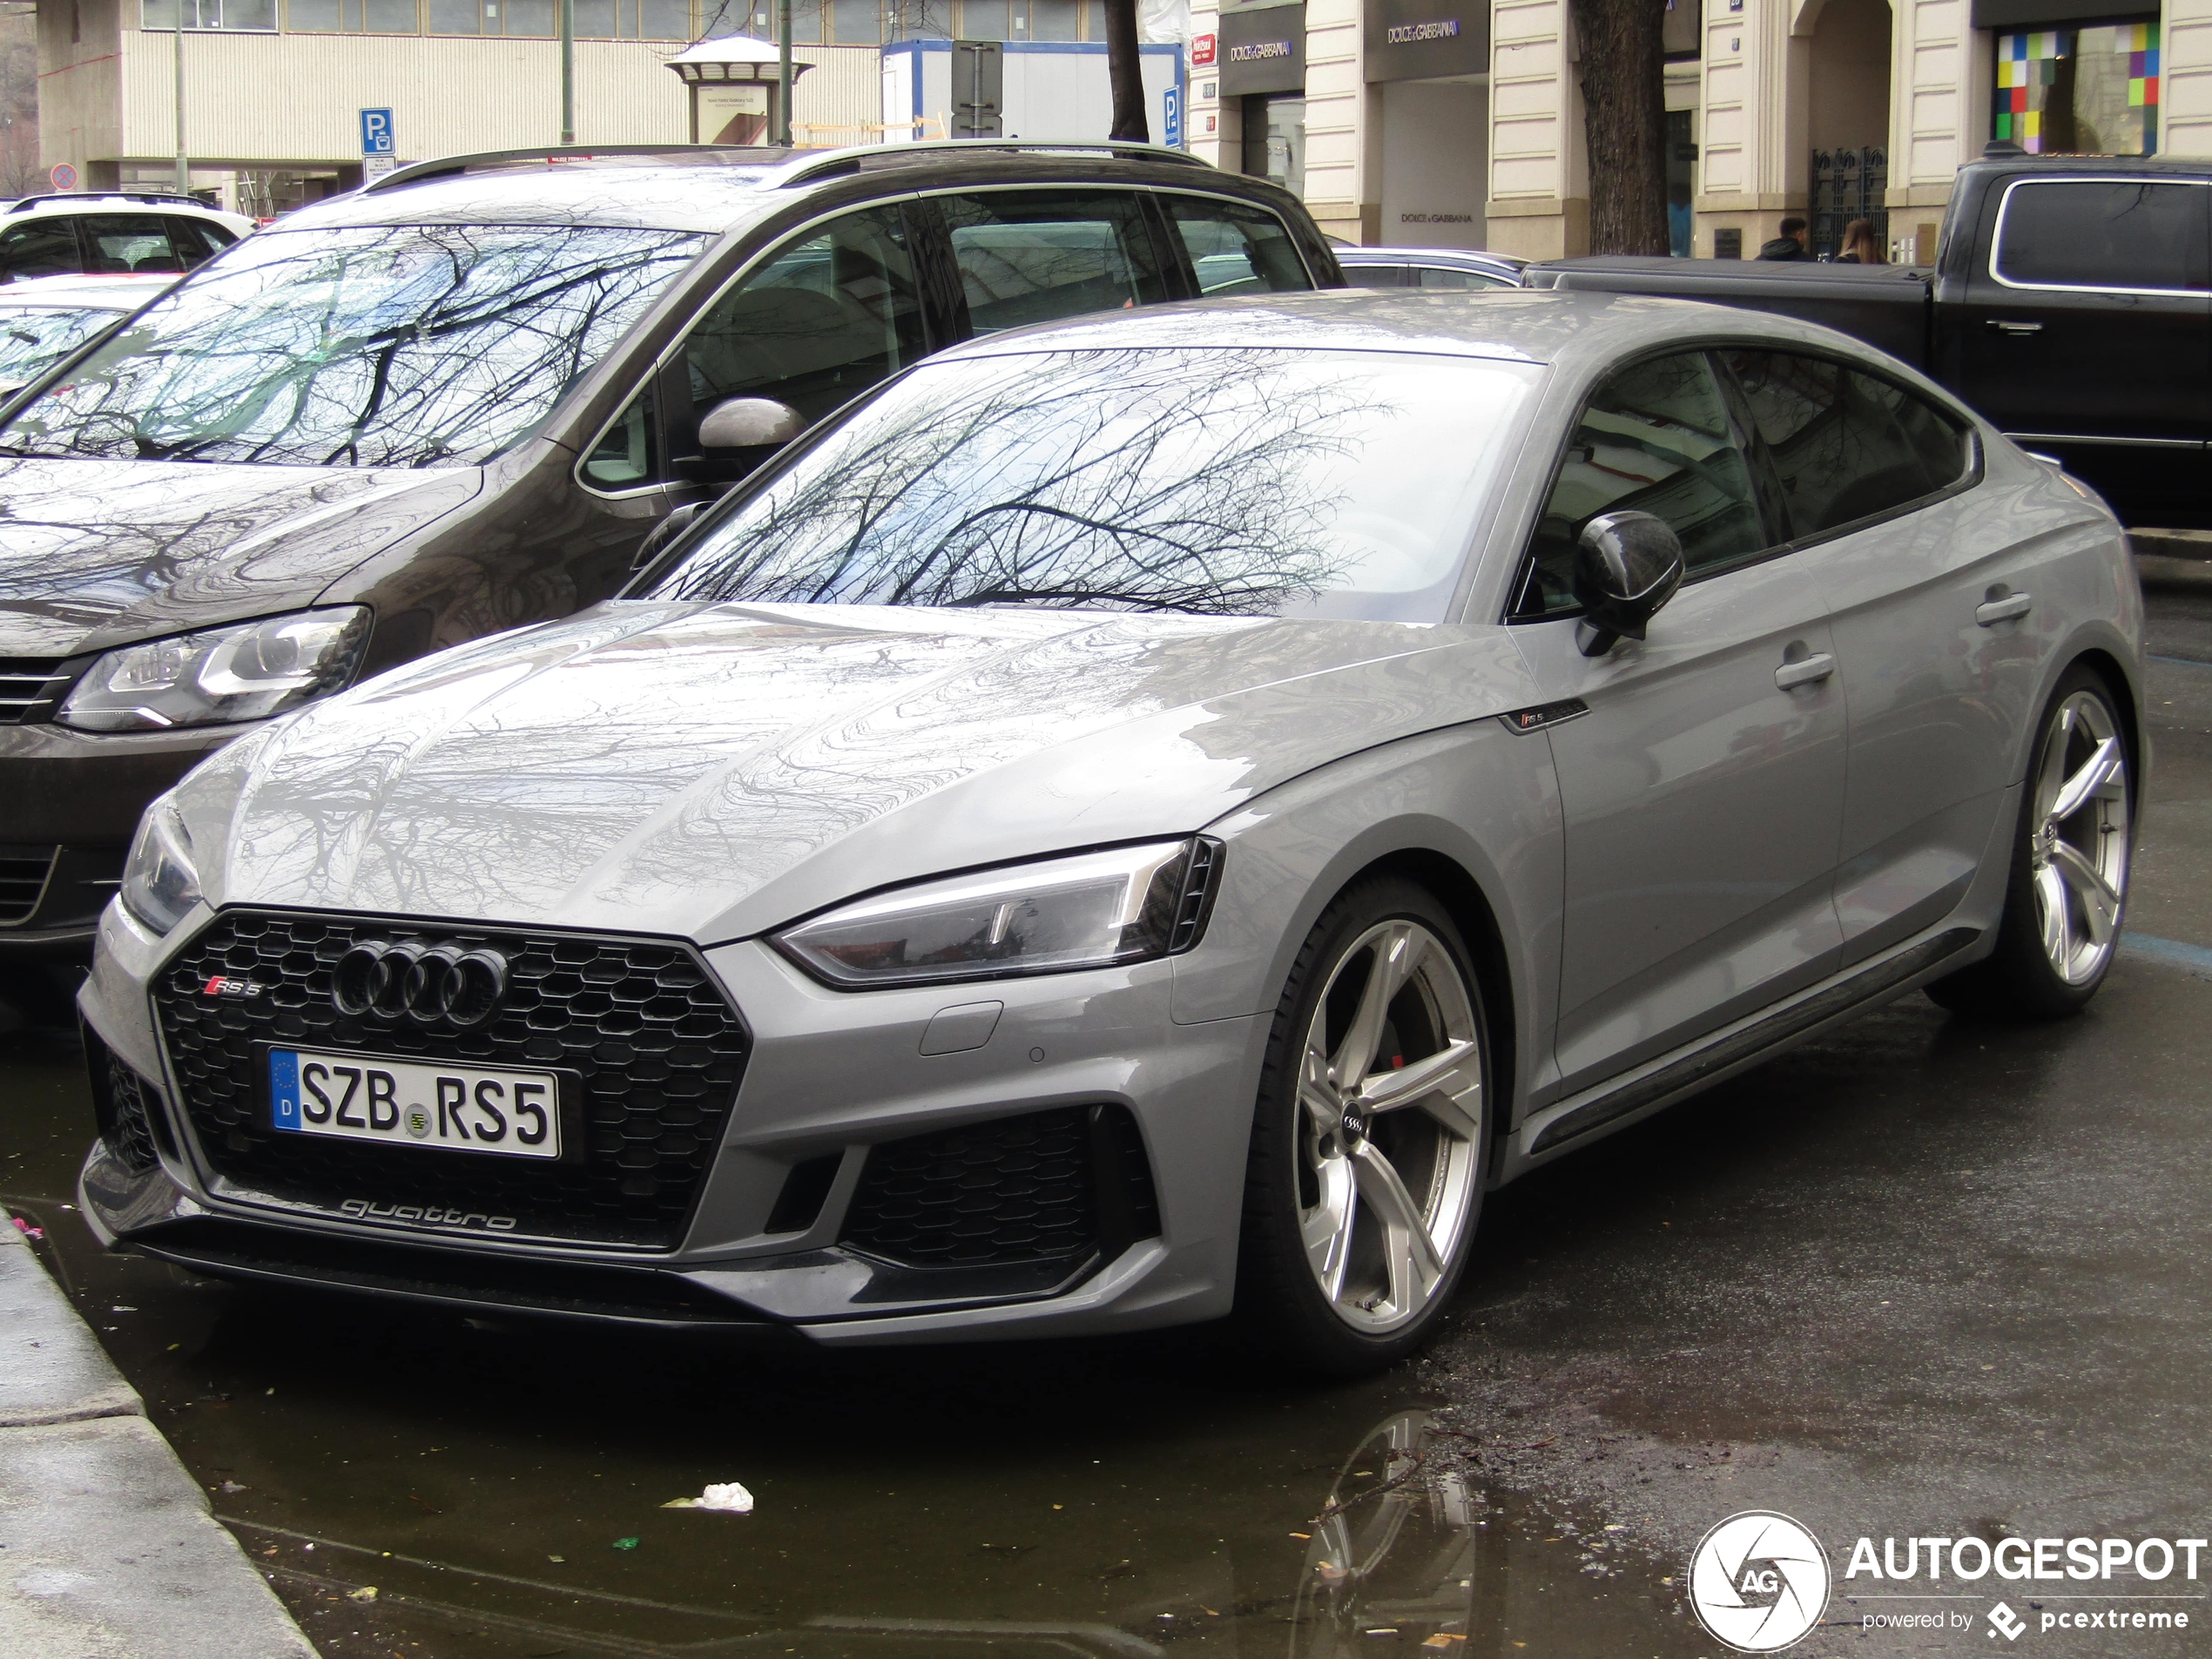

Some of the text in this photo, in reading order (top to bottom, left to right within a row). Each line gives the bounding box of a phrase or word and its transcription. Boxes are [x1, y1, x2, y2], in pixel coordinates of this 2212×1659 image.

[367, 113, 386, 140] P
[1166, 96, 1176, 130] P
[281, 1062, 549, 1145] D SZB RS5
[341, 1198, 517, 1230] quattro
